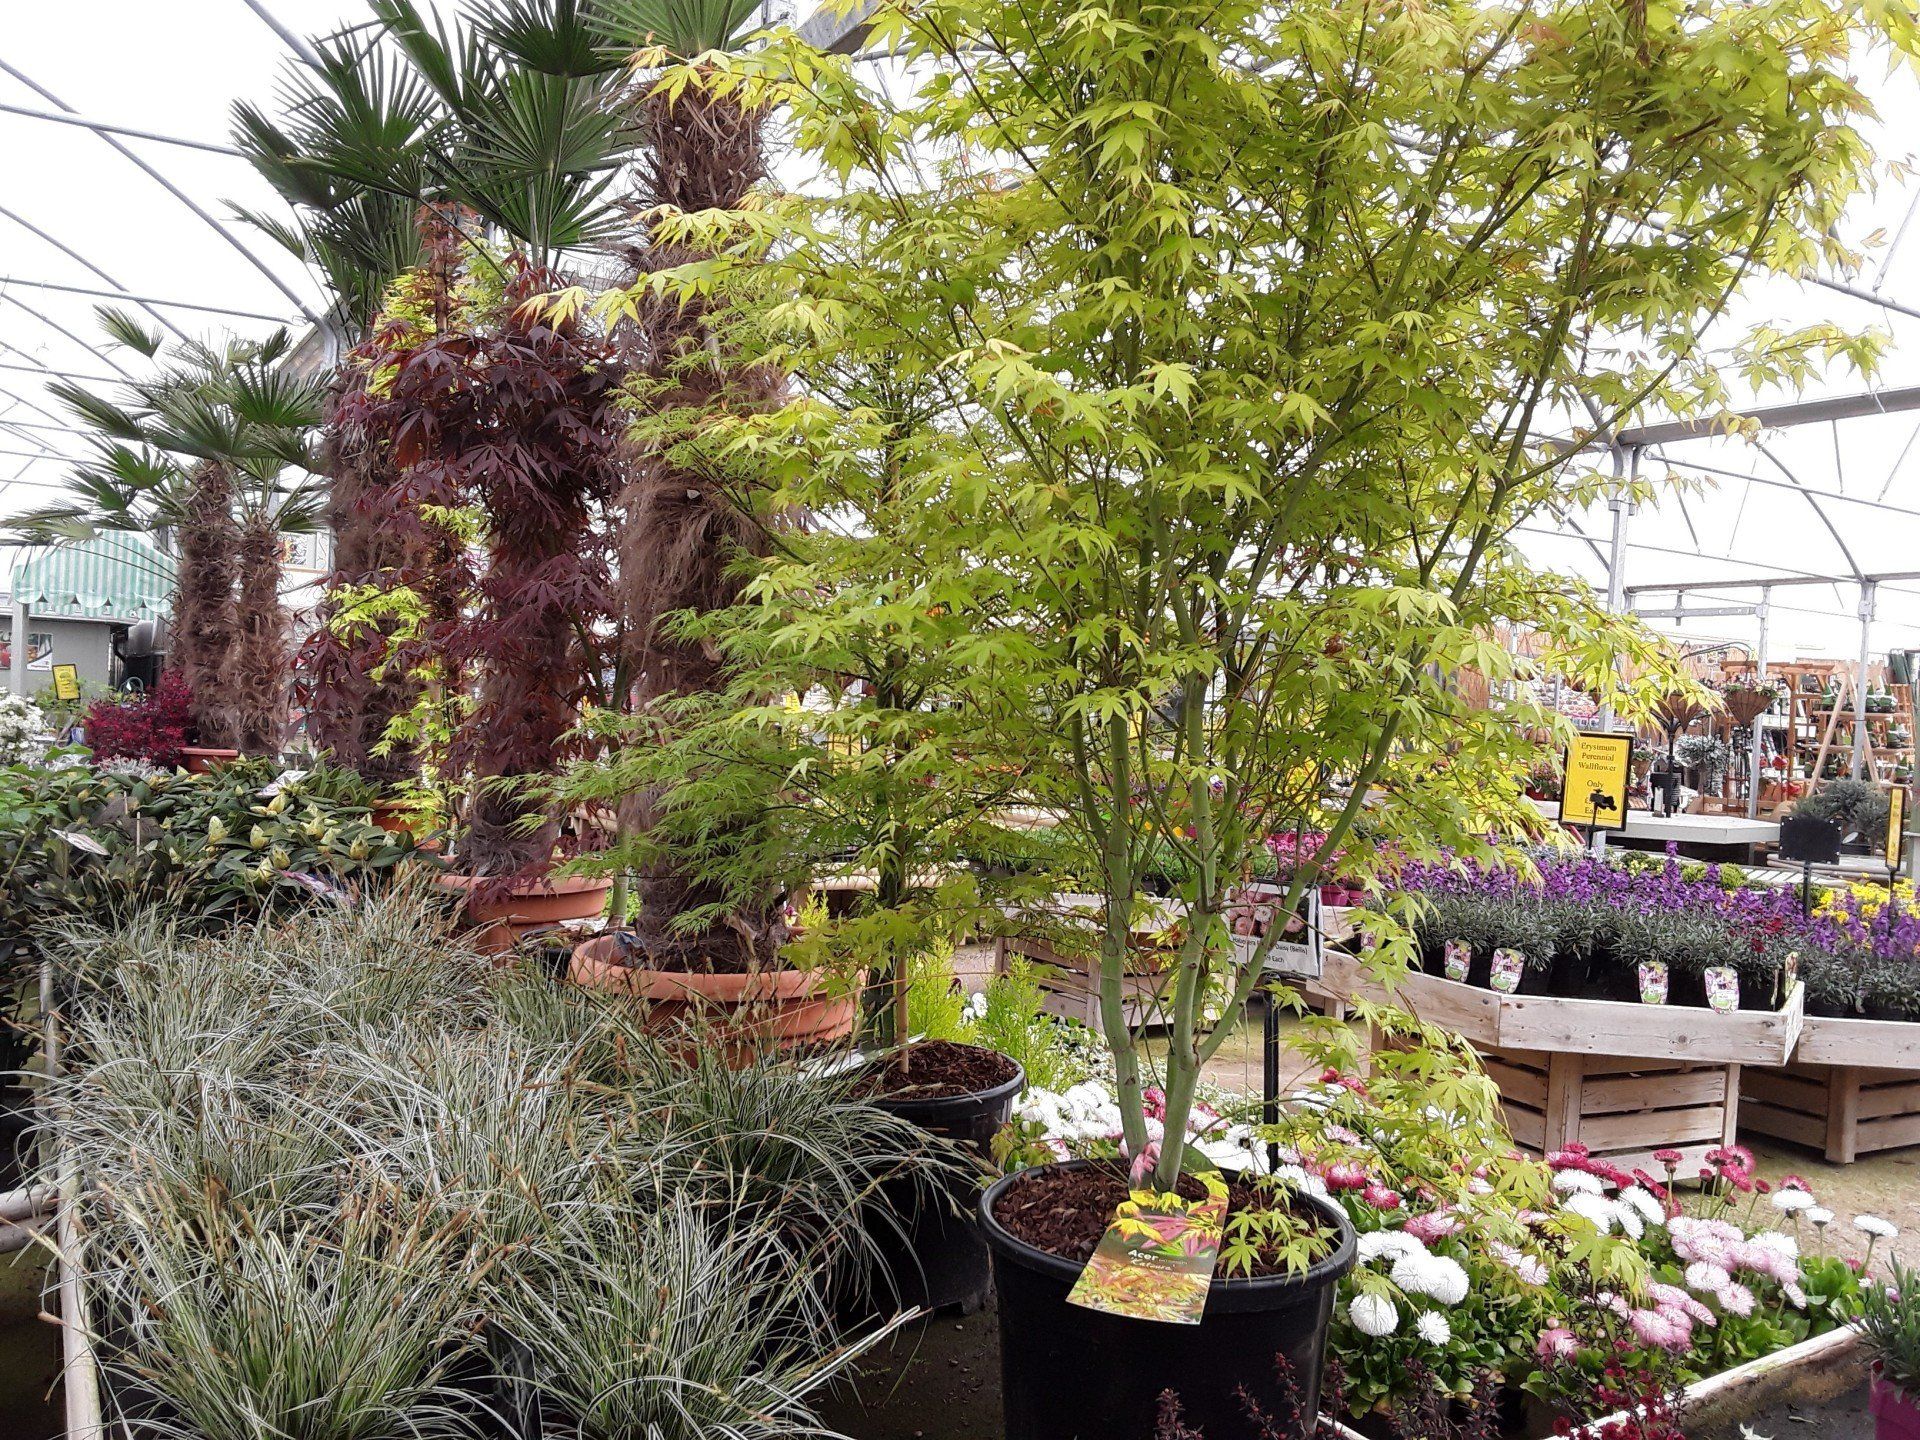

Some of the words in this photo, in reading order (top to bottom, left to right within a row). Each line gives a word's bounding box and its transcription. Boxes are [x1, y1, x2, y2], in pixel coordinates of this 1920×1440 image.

[1581, 742, 1617, 752] Erysimum
[1581, 753, 1615, 762] Perennial
[1578, 761, 1617, 772] Wallflower
[1587, 780, 1604, 788] Only
[1584, 806, 1602, 815] Eah
[1127, 1249, 1159, 1261] Acer
